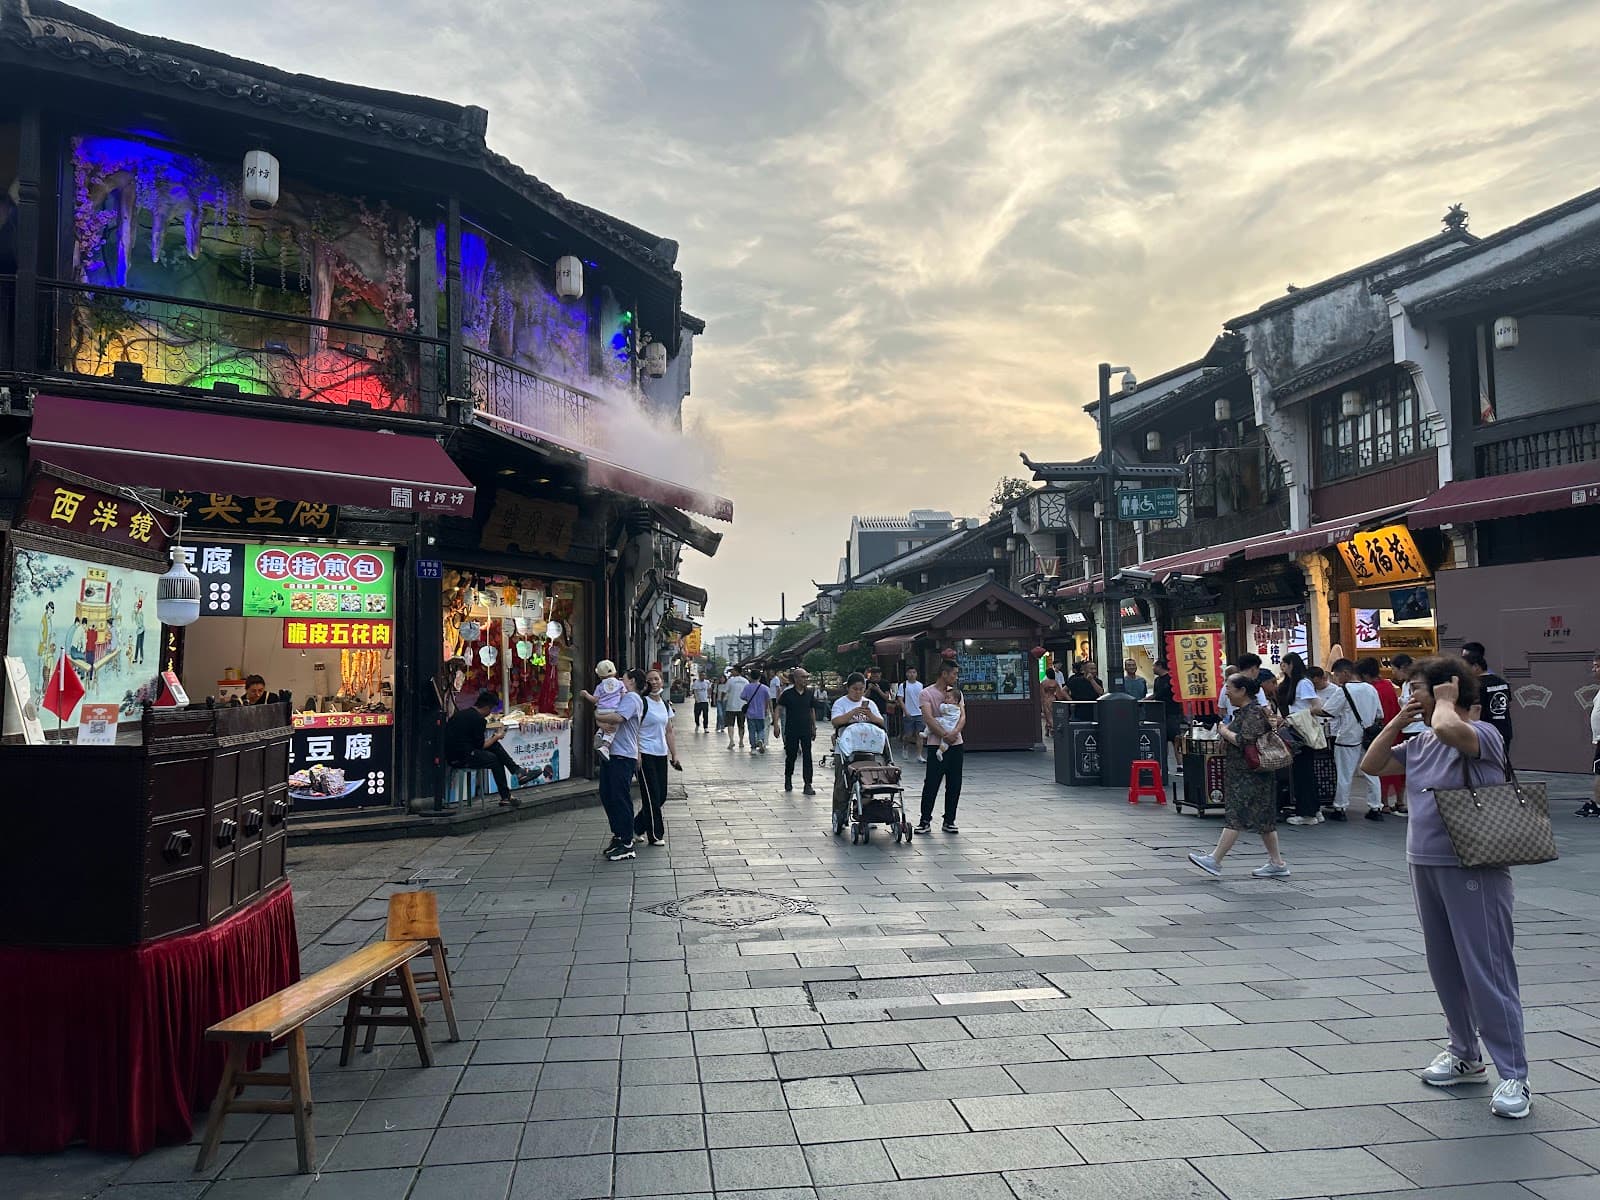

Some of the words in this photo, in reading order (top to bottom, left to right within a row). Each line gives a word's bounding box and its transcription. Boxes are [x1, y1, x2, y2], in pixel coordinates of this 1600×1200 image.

[50, 487, 154, 543] 西洋镜
[259, 554, 377, 579] 拇指煎包
[423, 568, 438, 577] 173
[287, 622, 390, 645] 脆皮五花肉
[1183, 649, 1210, 696] 武大郎餅
[326, 714, 388, 727] 长沙臭豆腐
[288, 732, 373, 764] 豆腐
